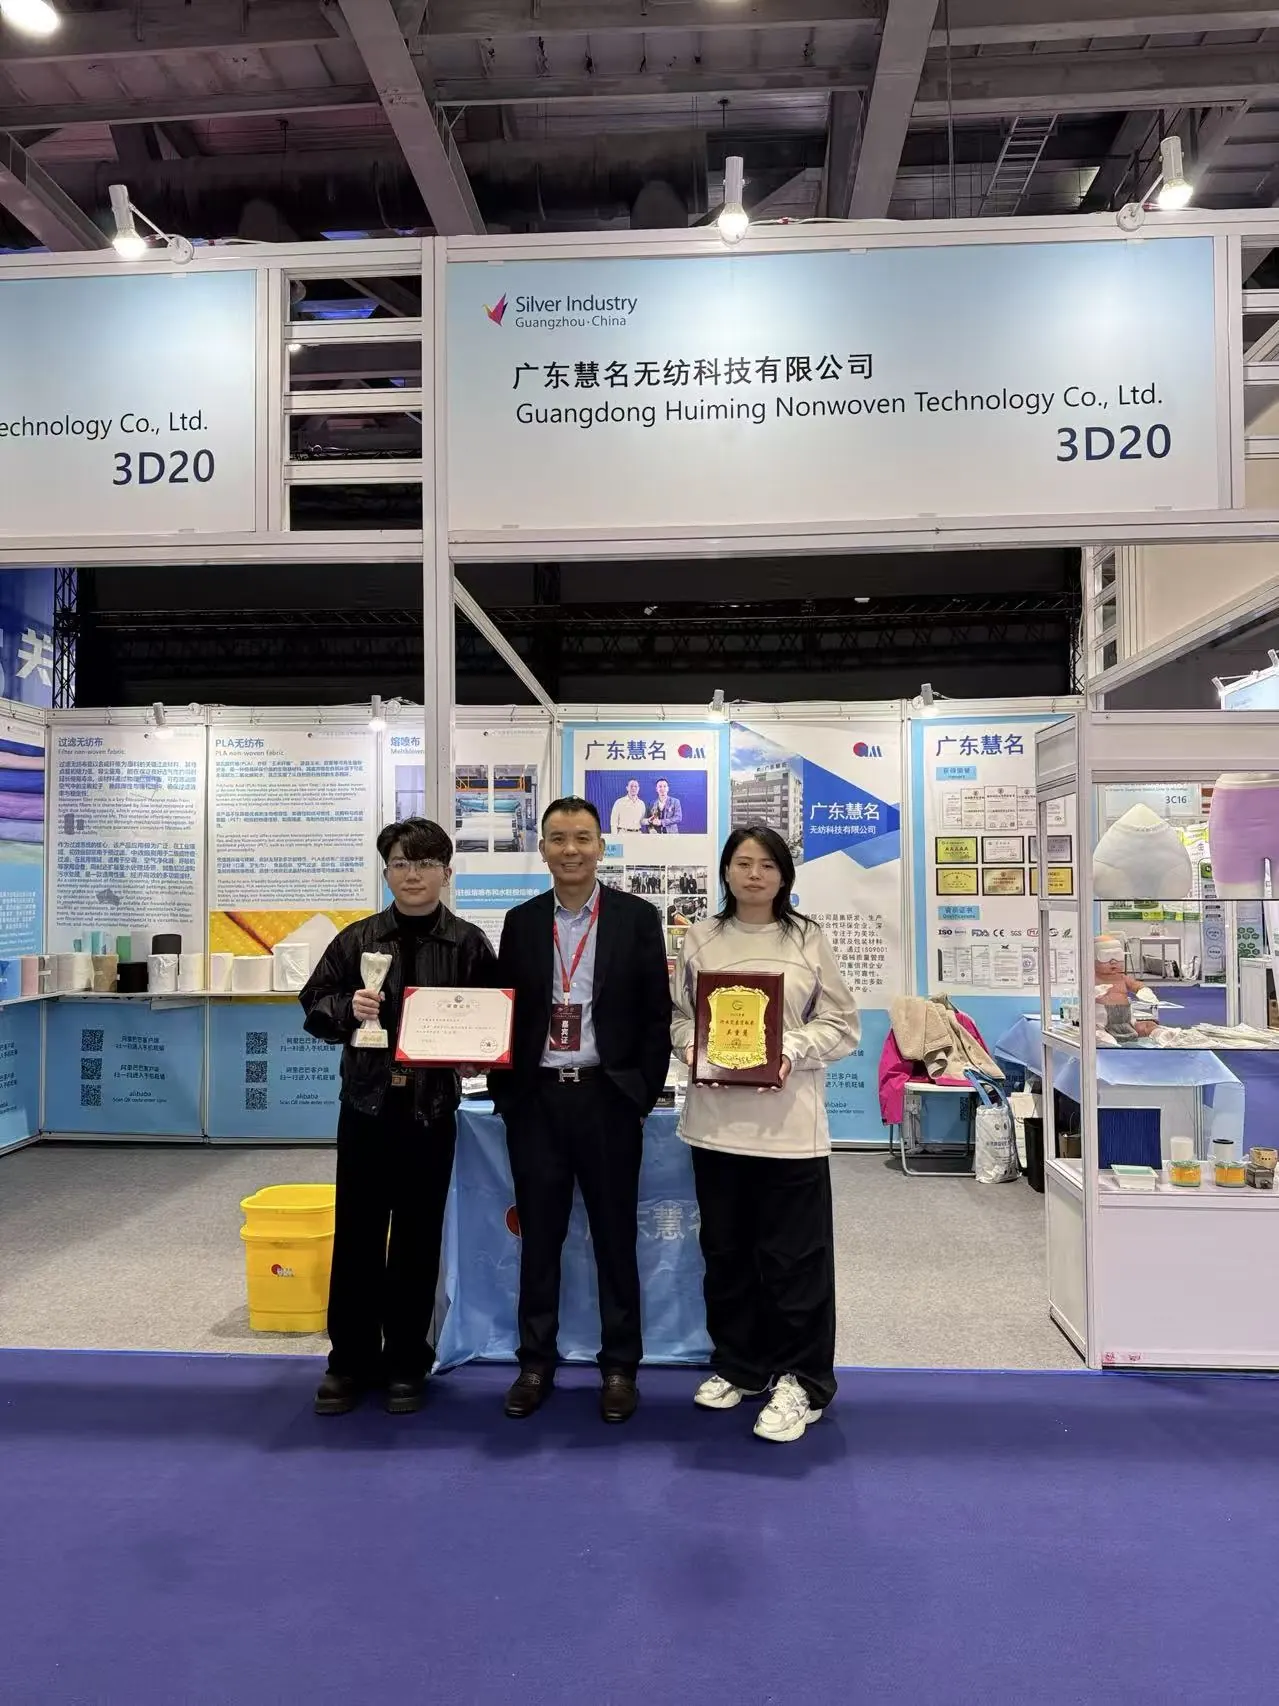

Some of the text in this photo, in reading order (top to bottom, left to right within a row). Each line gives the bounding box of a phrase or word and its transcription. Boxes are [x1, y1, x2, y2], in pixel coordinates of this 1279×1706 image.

[516, 295, 638, 314] Silver Industry
[512, 353, 873, 389] 广东慧名无纺科技有限公司
[516, 382, 1163, 429] Guangdong Huiming Nonwoven Technology Co., Ltd.
[0, 410, 208, 440] echnology Co., Ltd.
[1056, 423, 1172, 462] 3D20
[112, 449, 215, 485] 3D20
[58, 736, 103, 748] 过滤无纺布
[215, 738, 264, 749] PLA无纺布
[390, 736, 421, 748] 熔喷布
[585, 740, 666, 760] 广东慧名
[936, 734, 1024, 756] 广东慧名
[1165, 795, 1187, 804] 3C16
[810, 802, 880, 821] 广东慧名
[809, 825, 876, 834] 无纺科技有限公司
[972, 929, 990, 937] FDA
[993, 929, 1004, 938] CE
